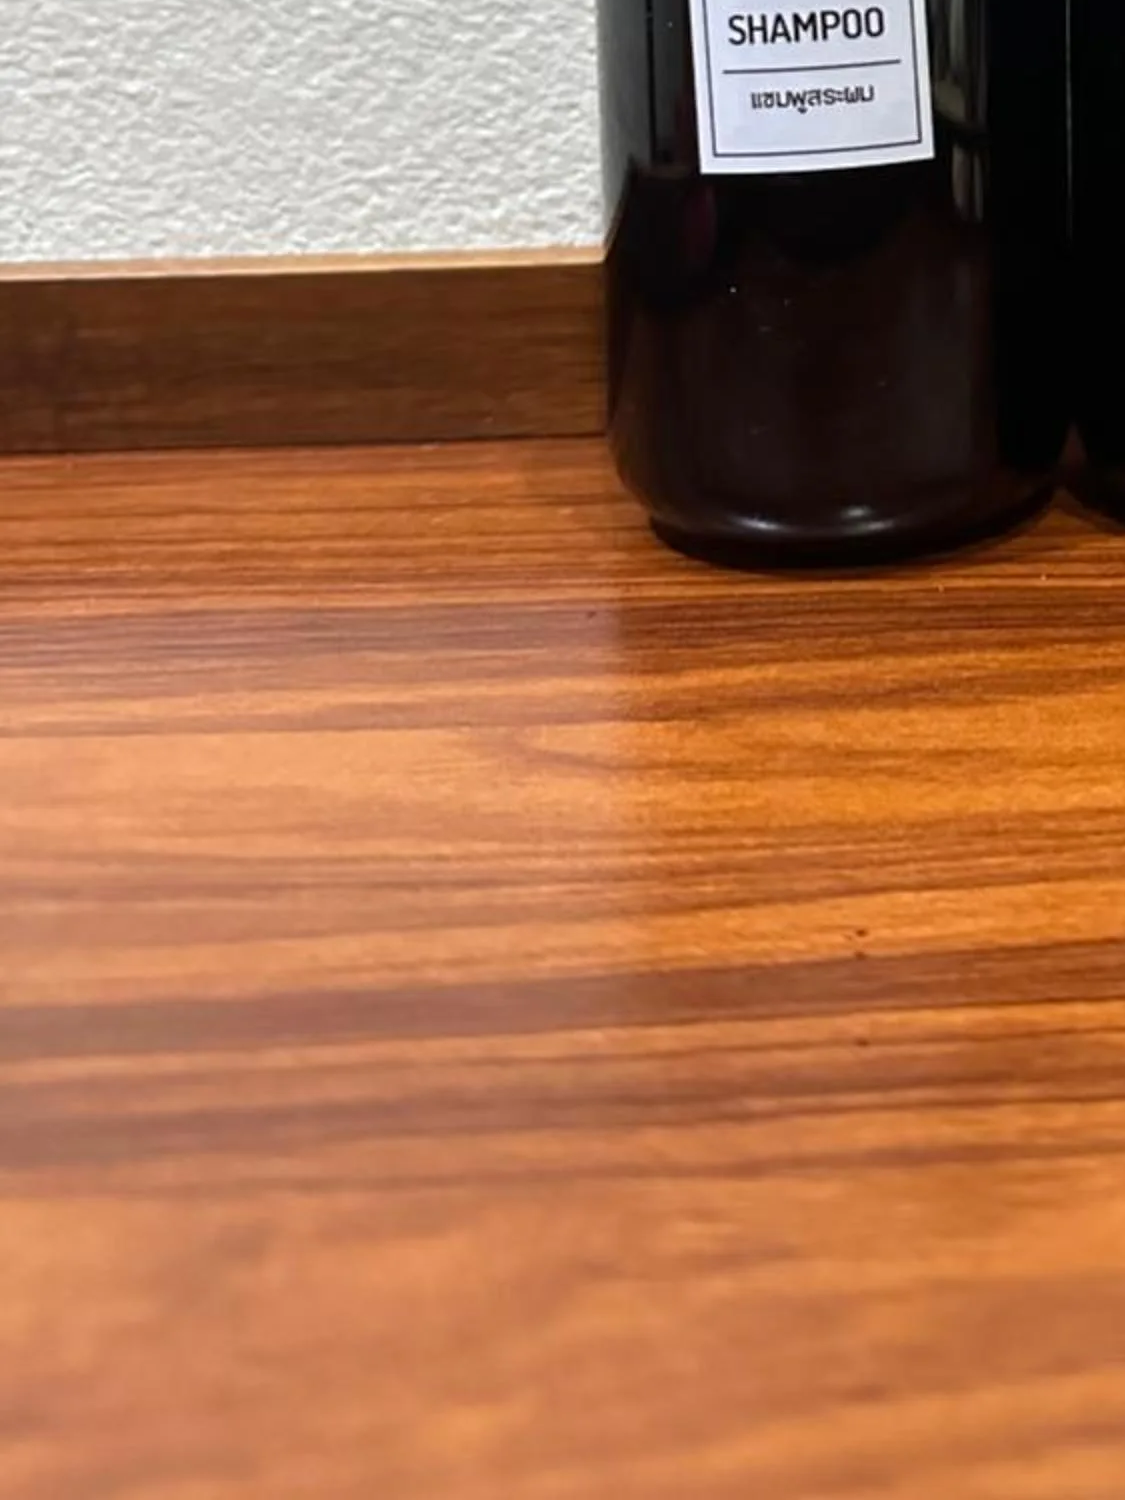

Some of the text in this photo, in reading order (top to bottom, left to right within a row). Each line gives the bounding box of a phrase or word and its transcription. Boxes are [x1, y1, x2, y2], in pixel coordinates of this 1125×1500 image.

[727, 6, 885, 46] SHAMPOO
[750, 84, 875, 114] แชมพูสระผม
